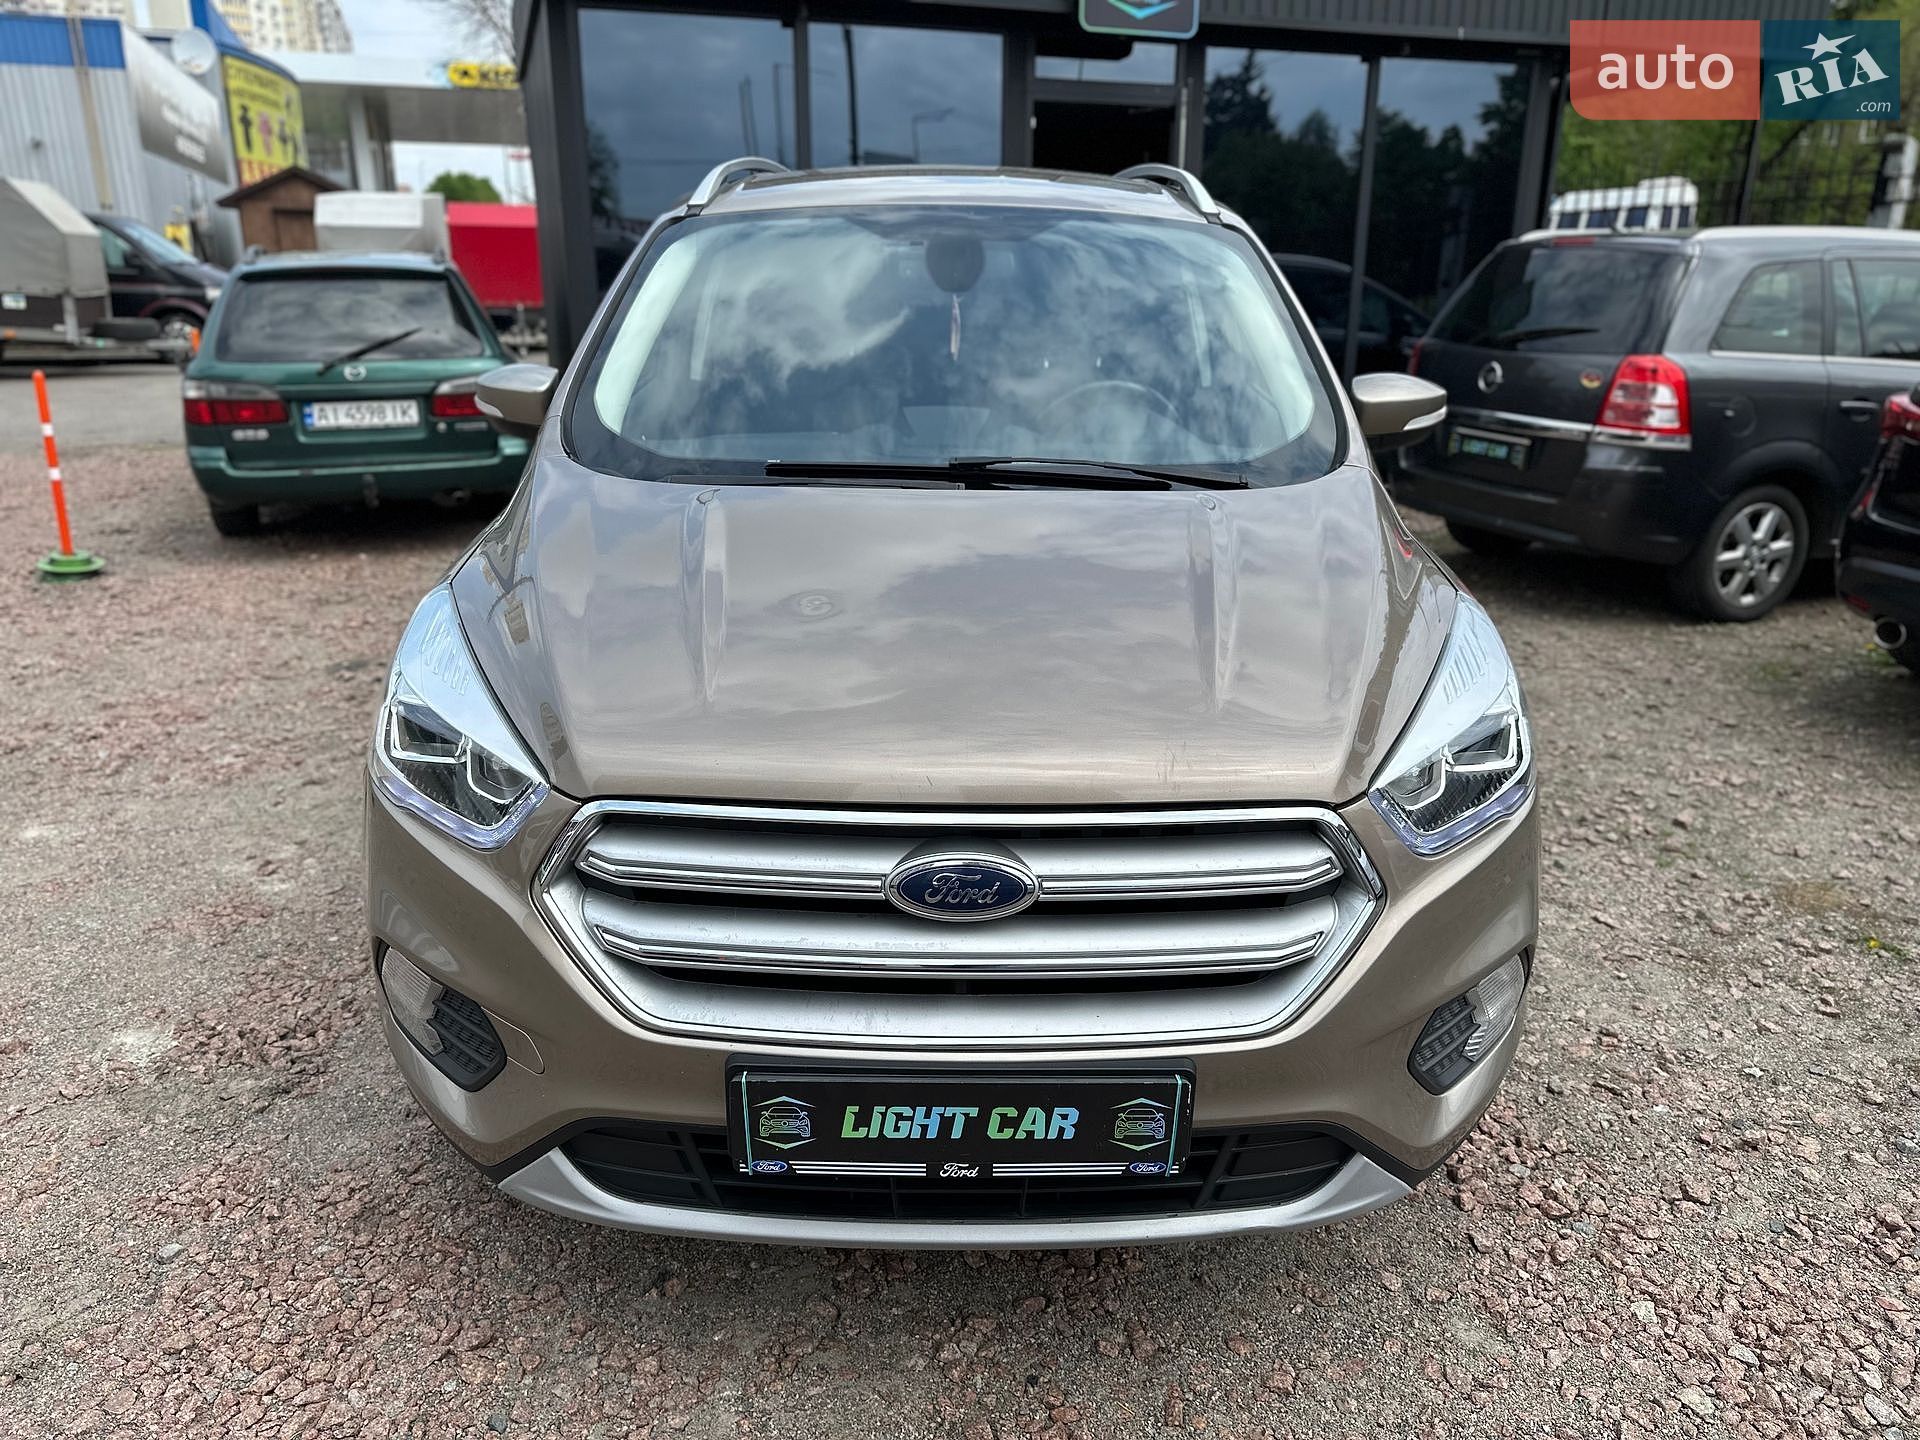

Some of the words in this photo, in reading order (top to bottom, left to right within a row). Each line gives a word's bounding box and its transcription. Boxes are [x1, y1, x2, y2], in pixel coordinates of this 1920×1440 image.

[924, 872, 1001, 904] Ford
[840, 1106, 979, 1140] LIGHT
[986, 1106, 1080, 1140] CAR
[756, 1160, 781, 1171] Ford
[939, 1162, 978, 1178] Ford
[1136, 1161, 1161, 1172] Ford
